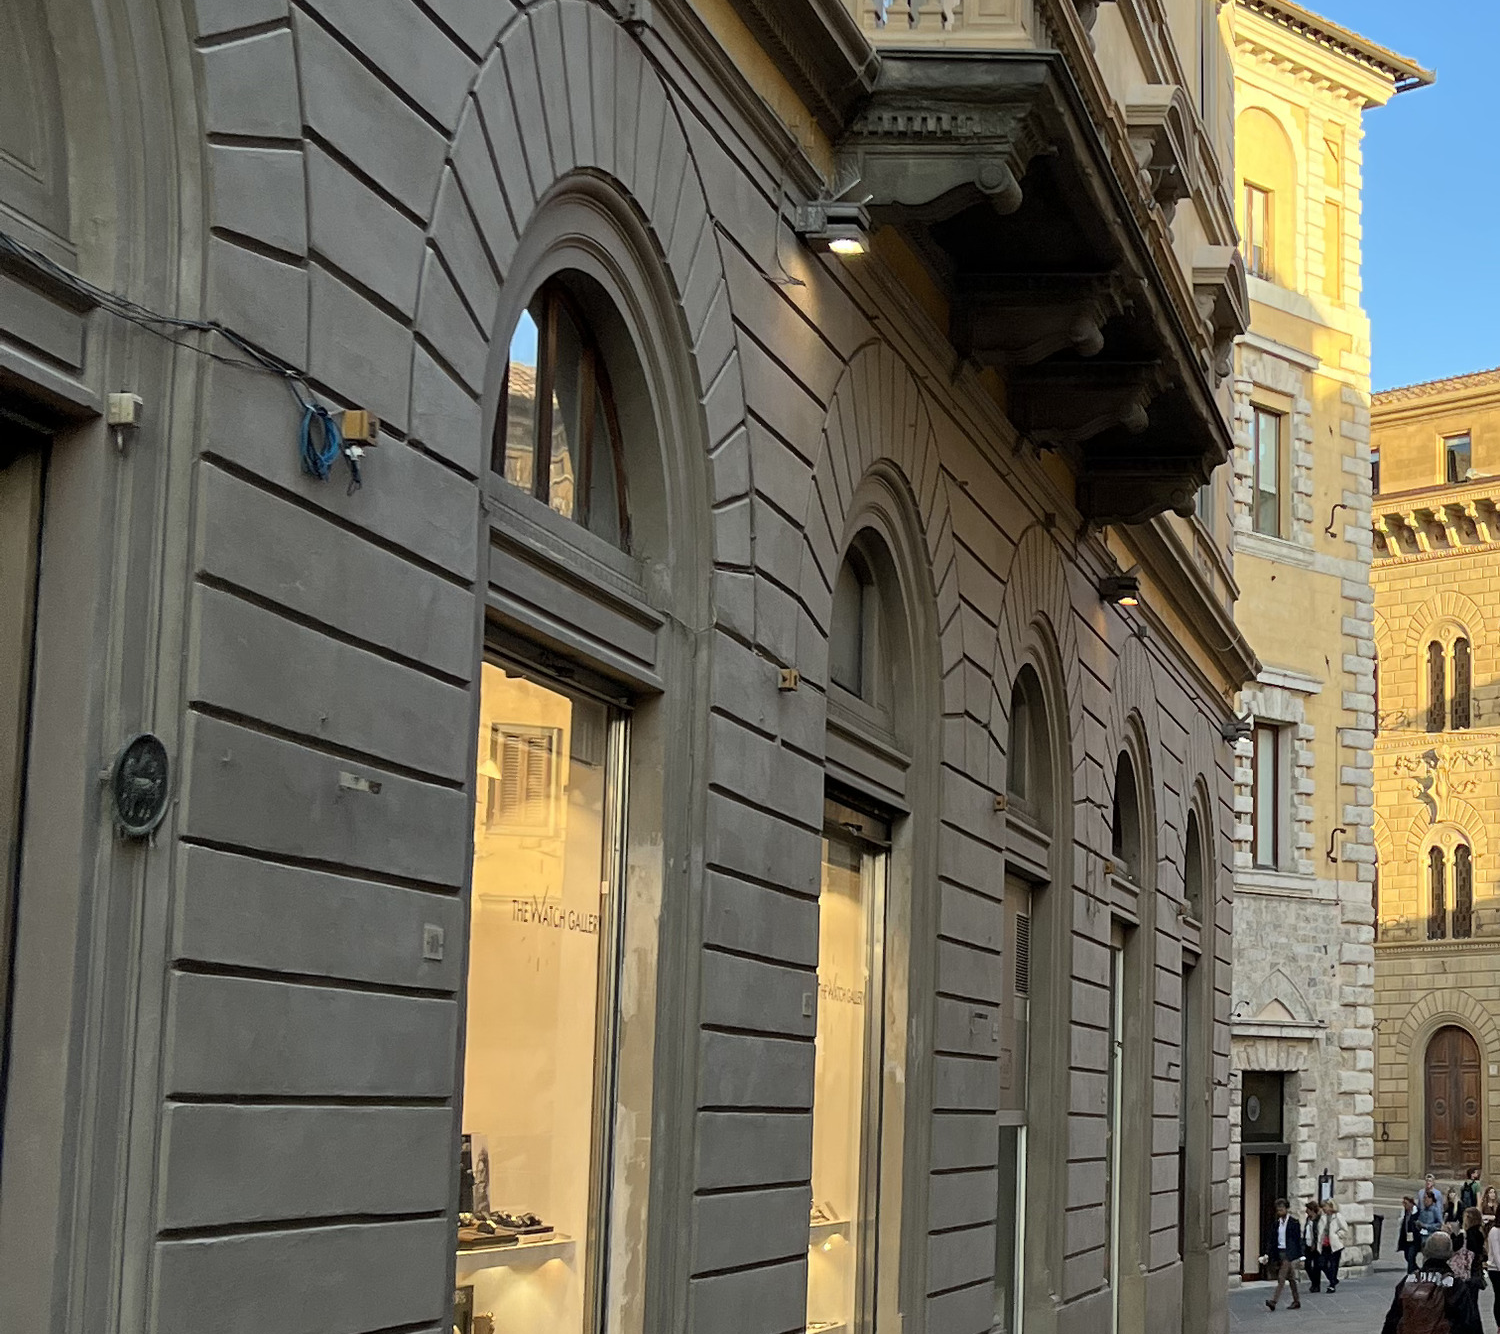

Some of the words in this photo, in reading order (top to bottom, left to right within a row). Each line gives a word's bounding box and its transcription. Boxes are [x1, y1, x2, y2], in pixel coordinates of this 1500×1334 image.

[512, 899, 529, 923] THE
[530, 885, 566, 929] WATCH
[568, 909, 602, 935] GALLER
